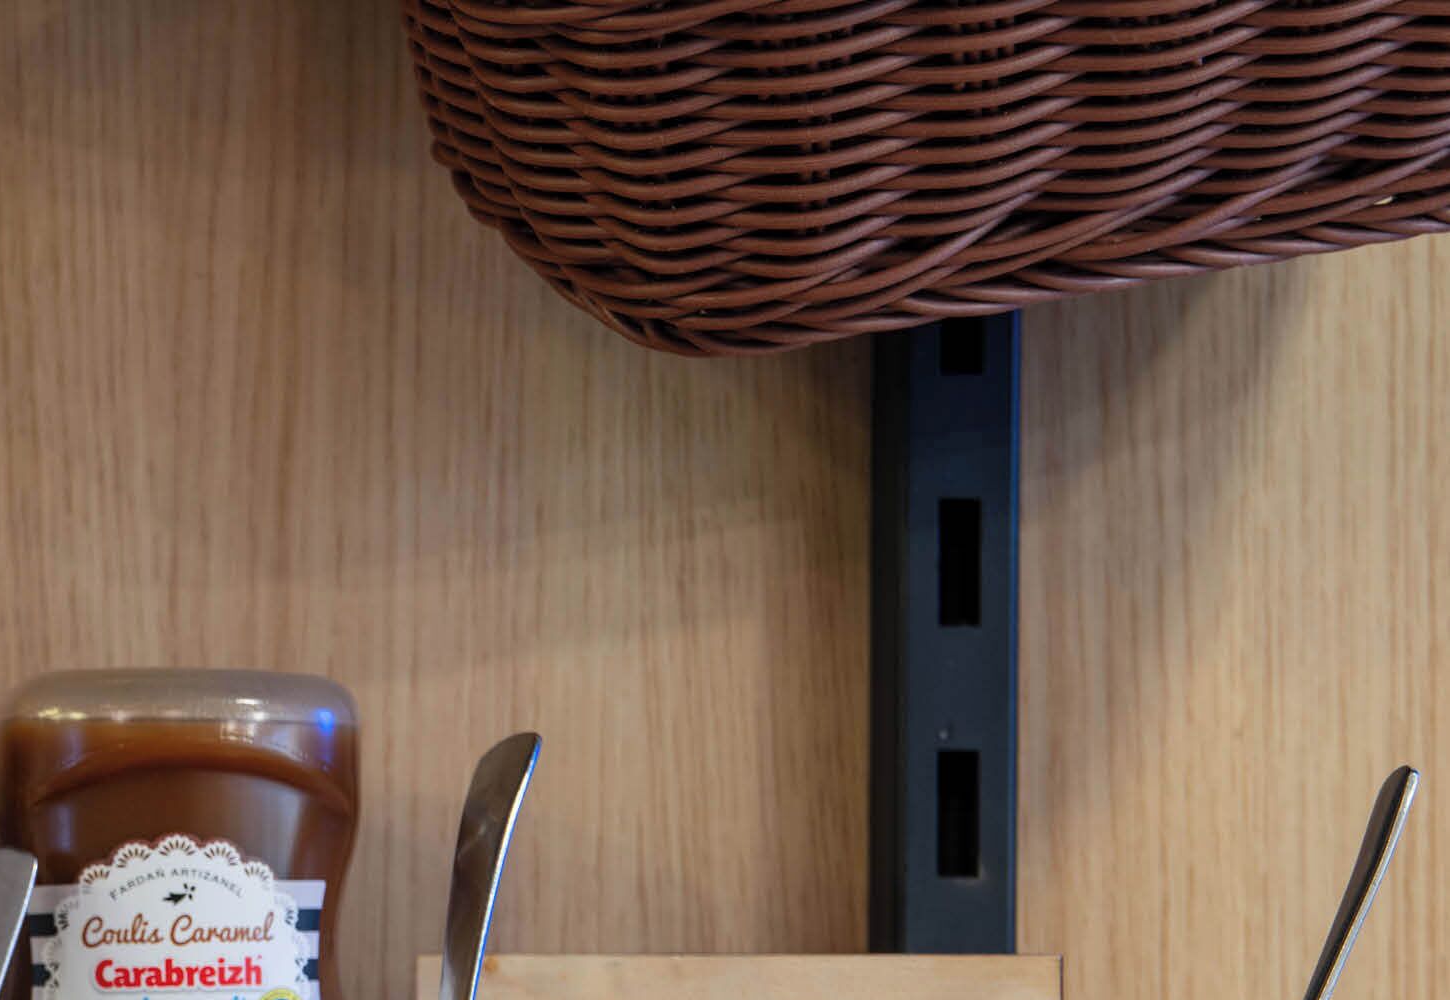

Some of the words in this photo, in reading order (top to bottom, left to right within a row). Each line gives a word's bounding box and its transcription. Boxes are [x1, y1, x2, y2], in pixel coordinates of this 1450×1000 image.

[82, 912, 164, 948] Coulis
[169, 911, 274, 946] Caramel
[94, 956, 263, 990] Carabreizh
